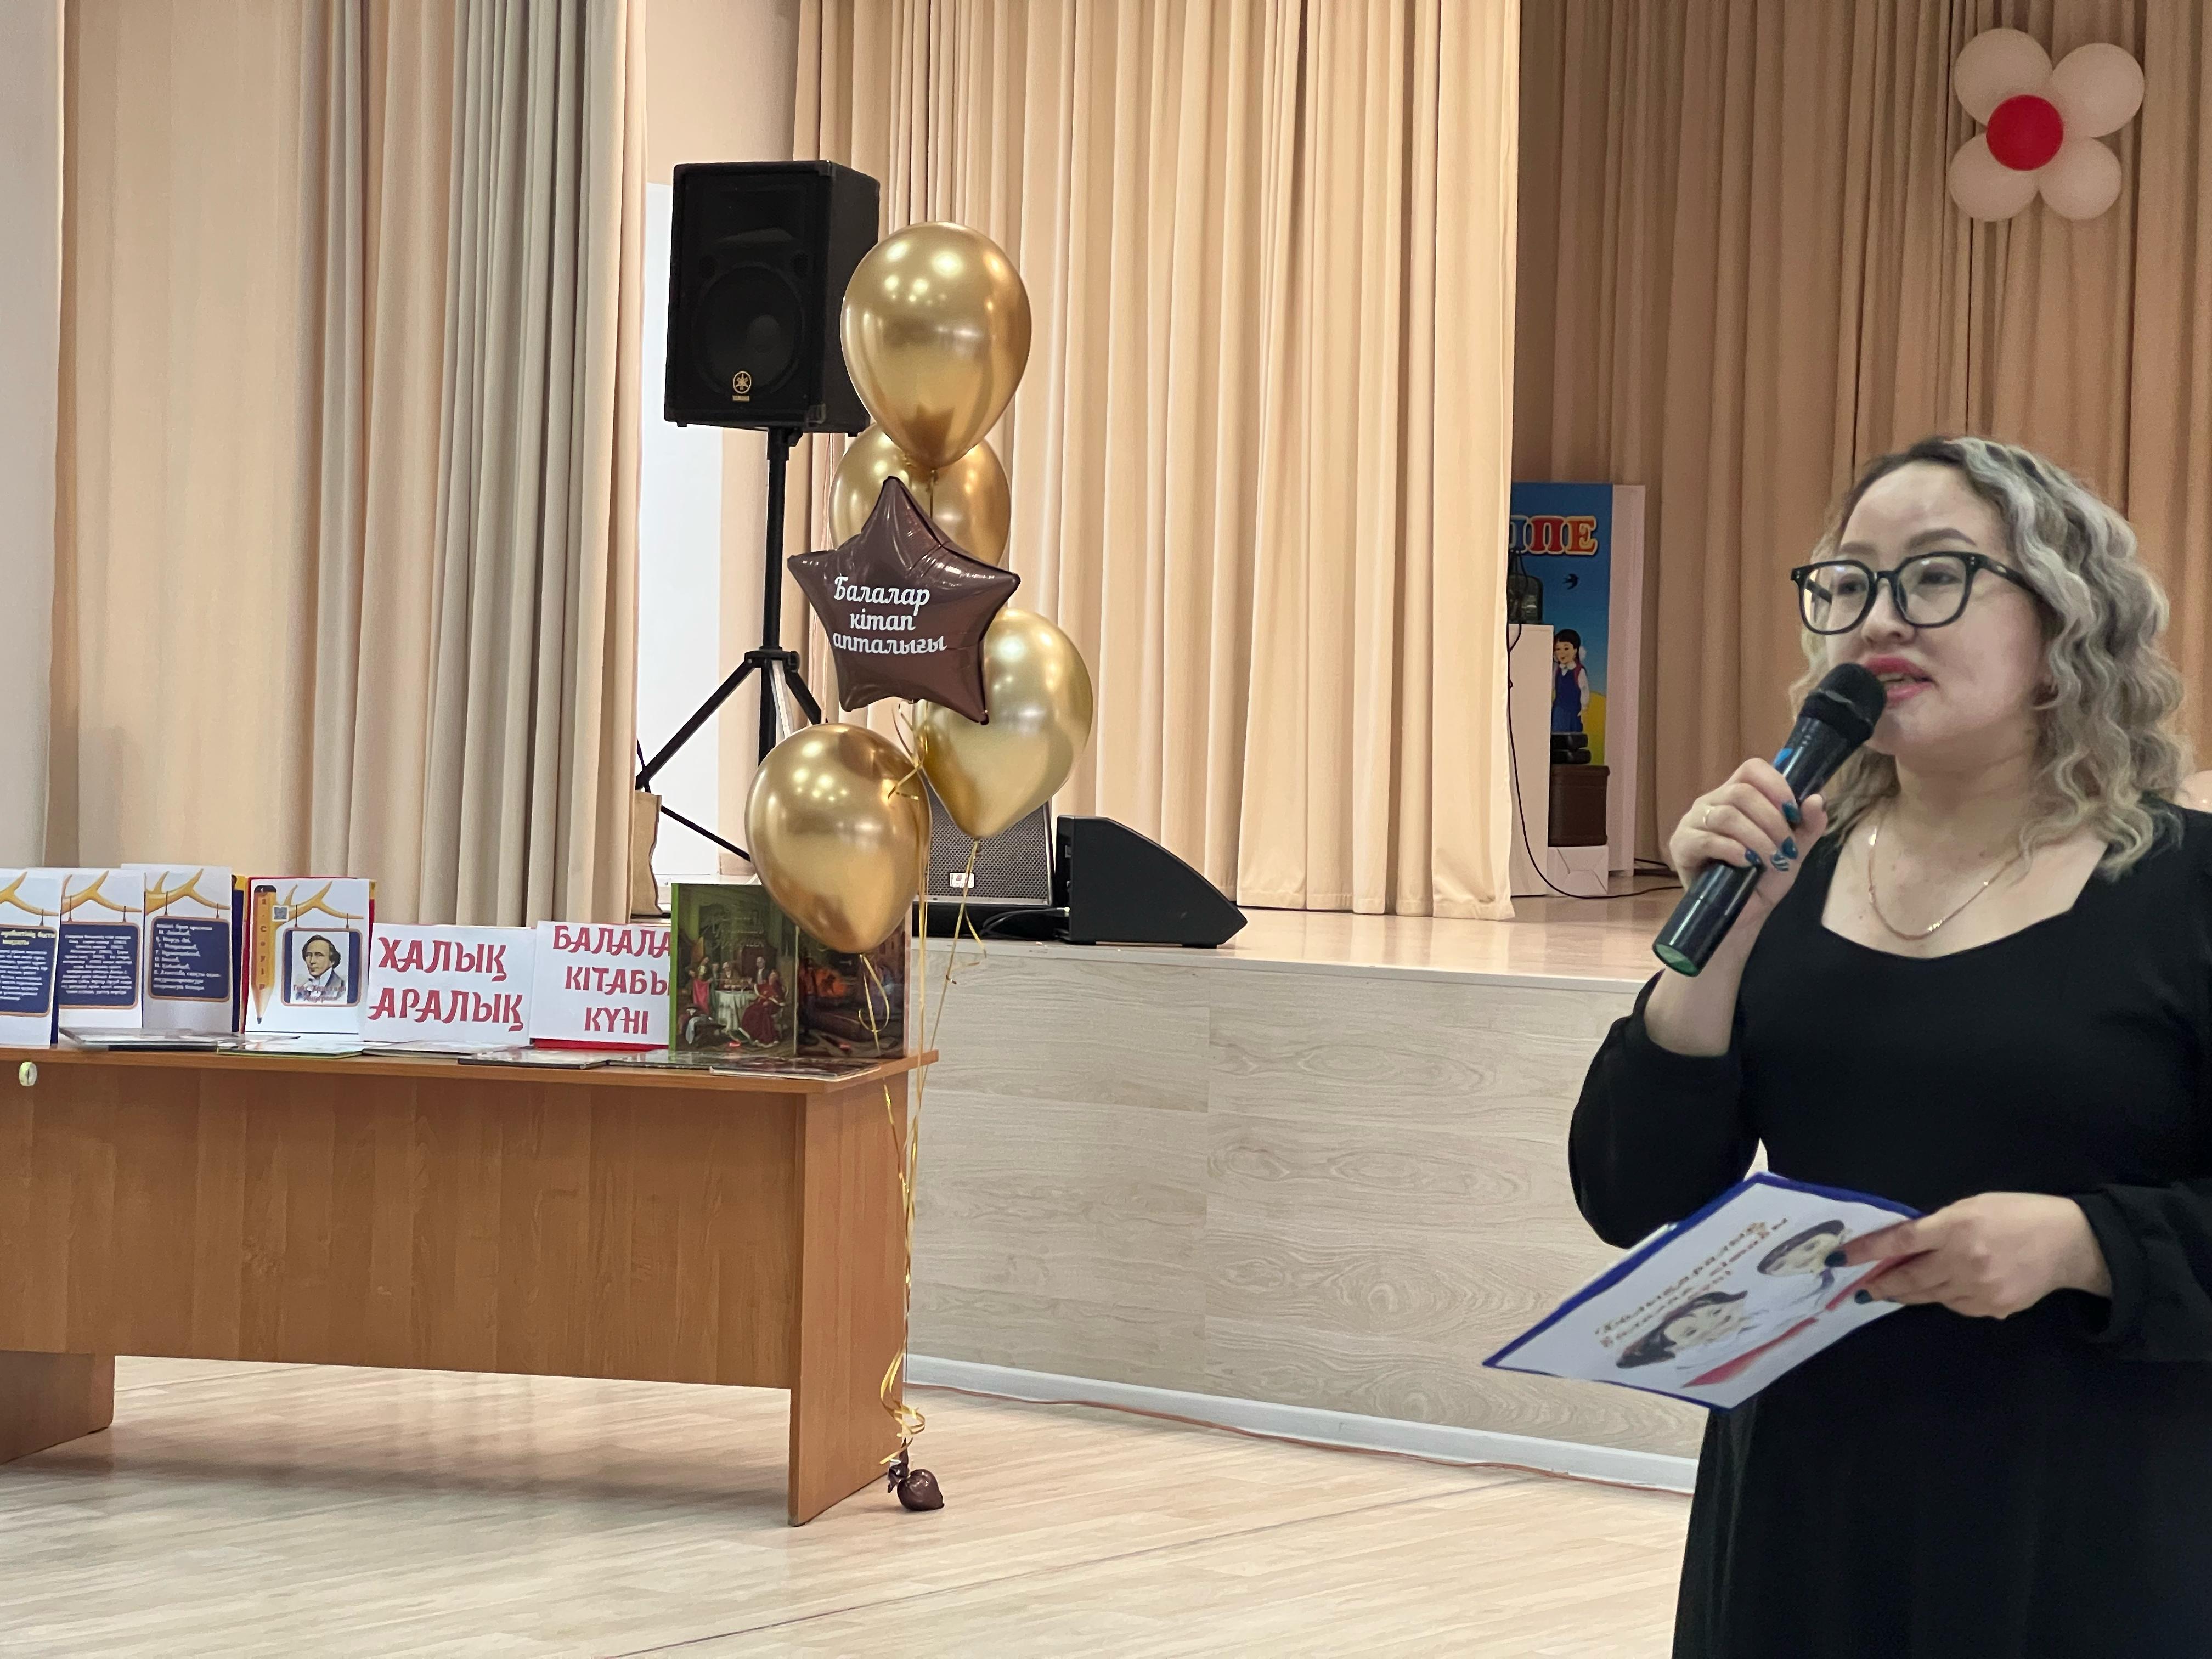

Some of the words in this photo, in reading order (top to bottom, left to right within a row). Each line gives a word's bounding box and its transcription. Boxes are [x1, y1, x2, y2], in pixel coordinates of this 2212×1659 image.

[833, 573, 930, 616] Балалар
[850, 608, 916, 631] кітап
[832, 633, 948, 654] апталығы
[553, 925, 670, 958] БАЛАЛА
[378, 936, 507, 982] ХАЛЫҚ
[367, 988, 523, 1032] АРАЛЫҚ
[584, 1007, 649, 1035] КҮНІ
